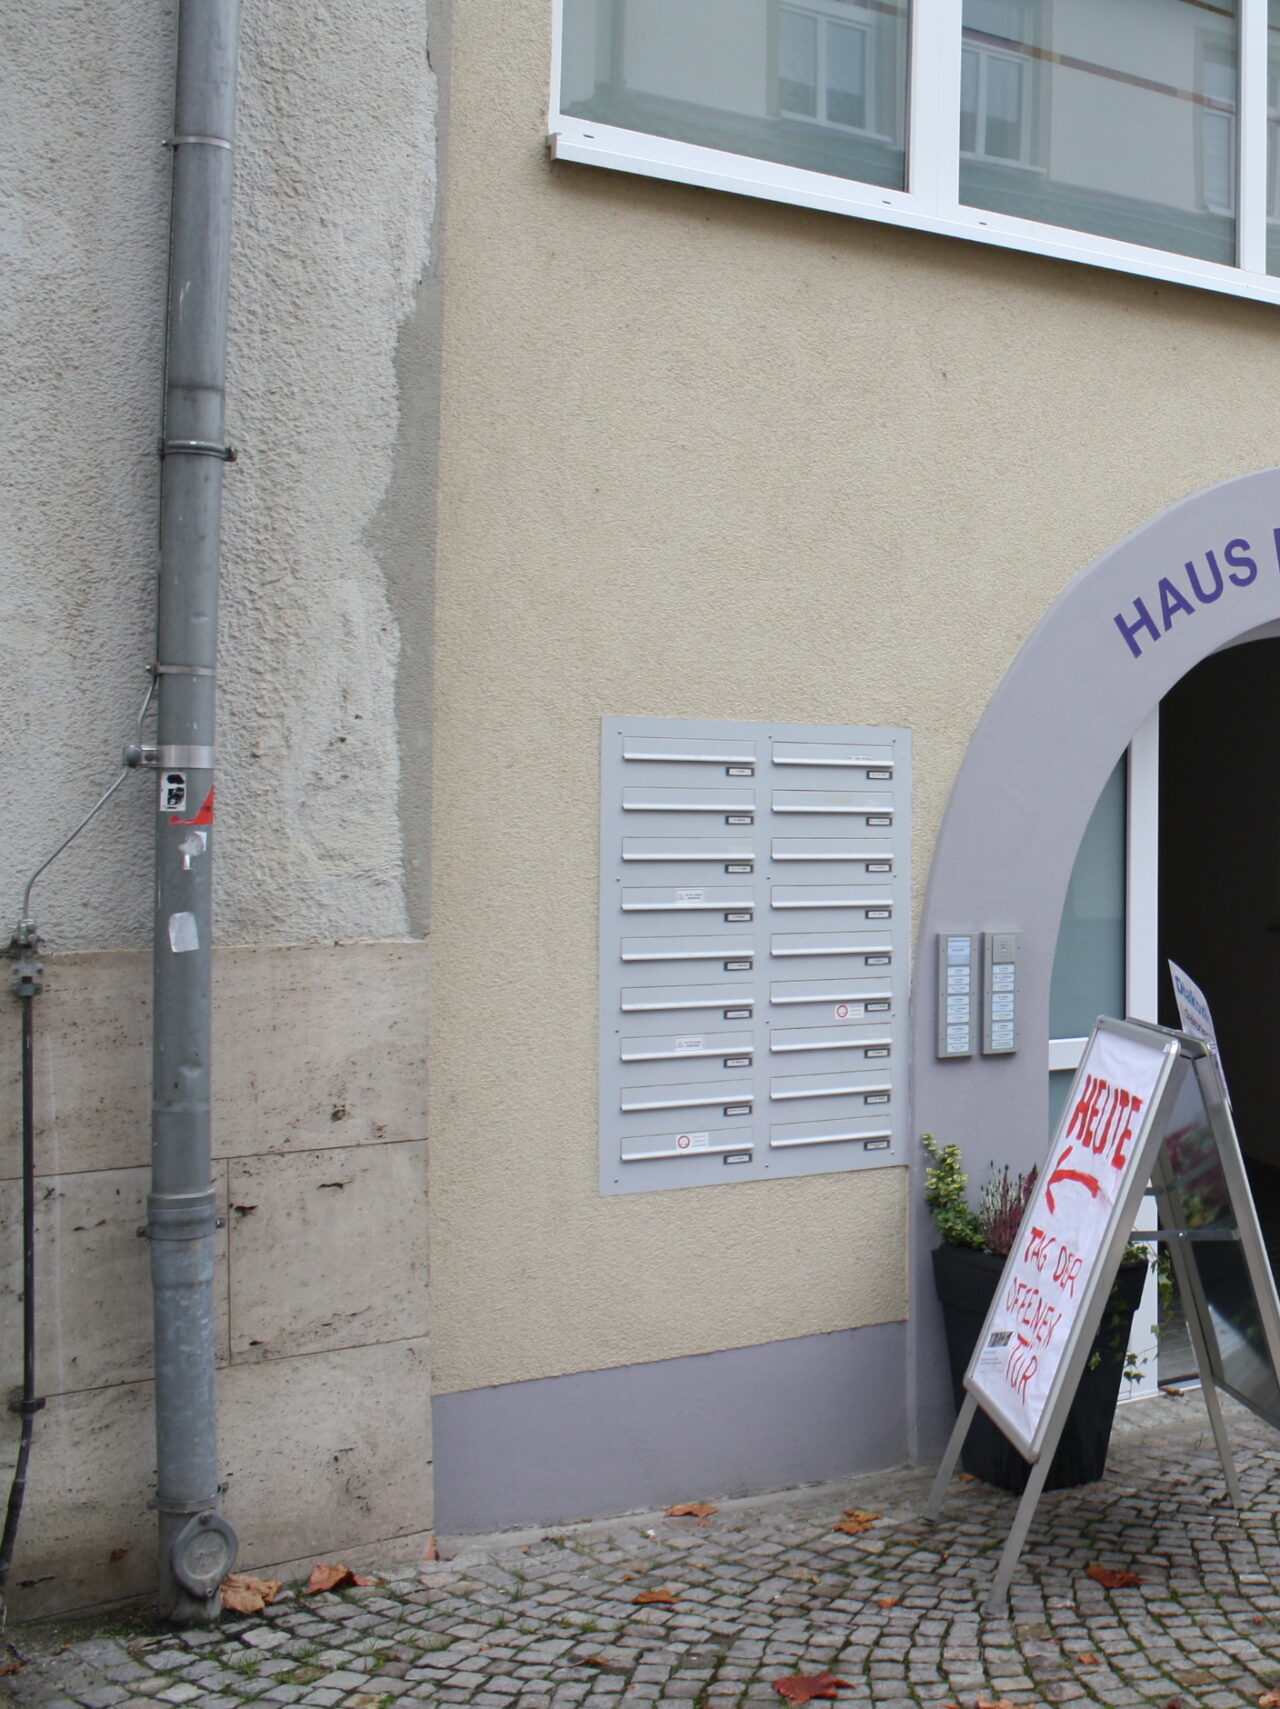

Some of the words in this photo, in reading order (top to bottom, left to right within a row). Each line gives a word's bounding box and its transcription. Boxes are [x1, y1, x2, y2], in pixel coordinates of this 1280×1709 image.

[1113, 538, 1258, 658] HAUS
[1066, 1074, 1143, 1170] HEUTE
[1024, 1226, 1056, 1274] TAG
[1053, 1245, 1083, 1299] DER
[1006, 1333, 1038, 1406] TÜR
